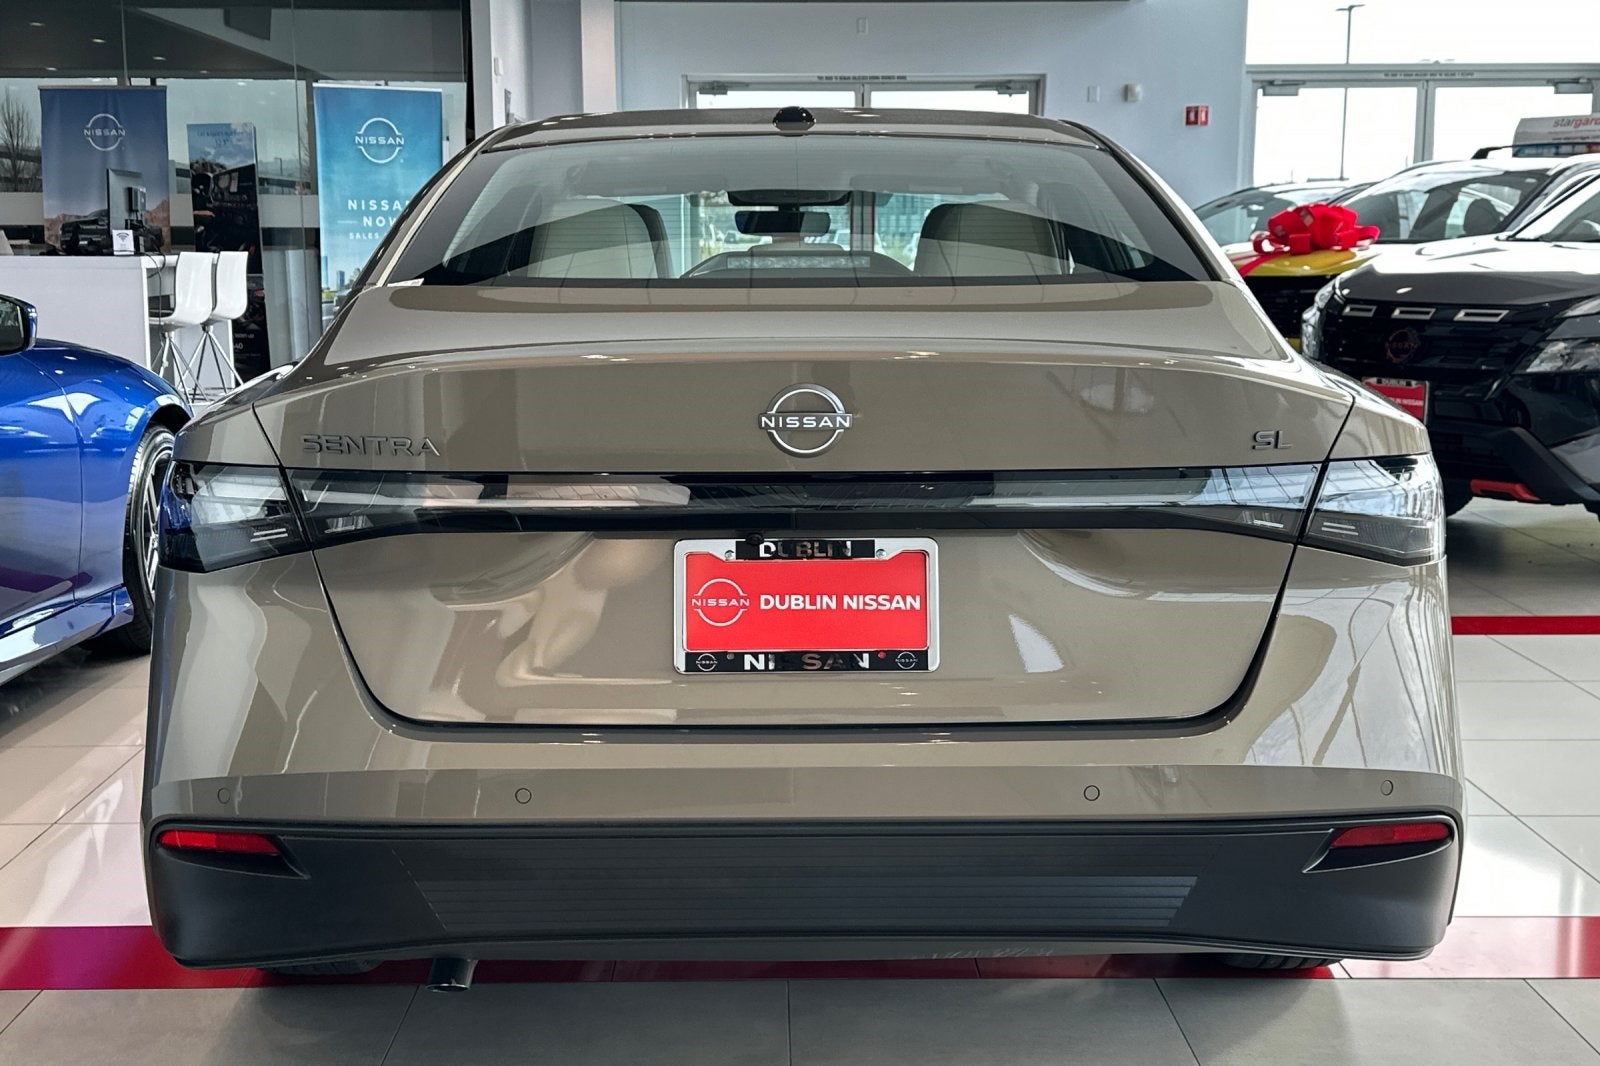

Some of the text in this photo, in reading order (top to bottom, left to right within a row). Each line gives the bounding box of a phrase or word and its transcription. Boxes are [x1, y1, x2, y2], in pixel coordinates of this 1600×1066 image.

[83, 128, 126, 137] NISSAN
[355, 135, 405, 145] NISSAN
[347, 199, 410, 212] NISSA
[349, 232, 379, 240] SALES
[761, 416, 850, 428] NISSAN
[303, 434, 440, 457] SENTRA
[1252, 430, 1293, 450] SL
[691, 598, 750, 607] NISSAN
[760, 594, 921, 611] DUBLIN NISSAN
[743, 653, 870, 670] NISAN
